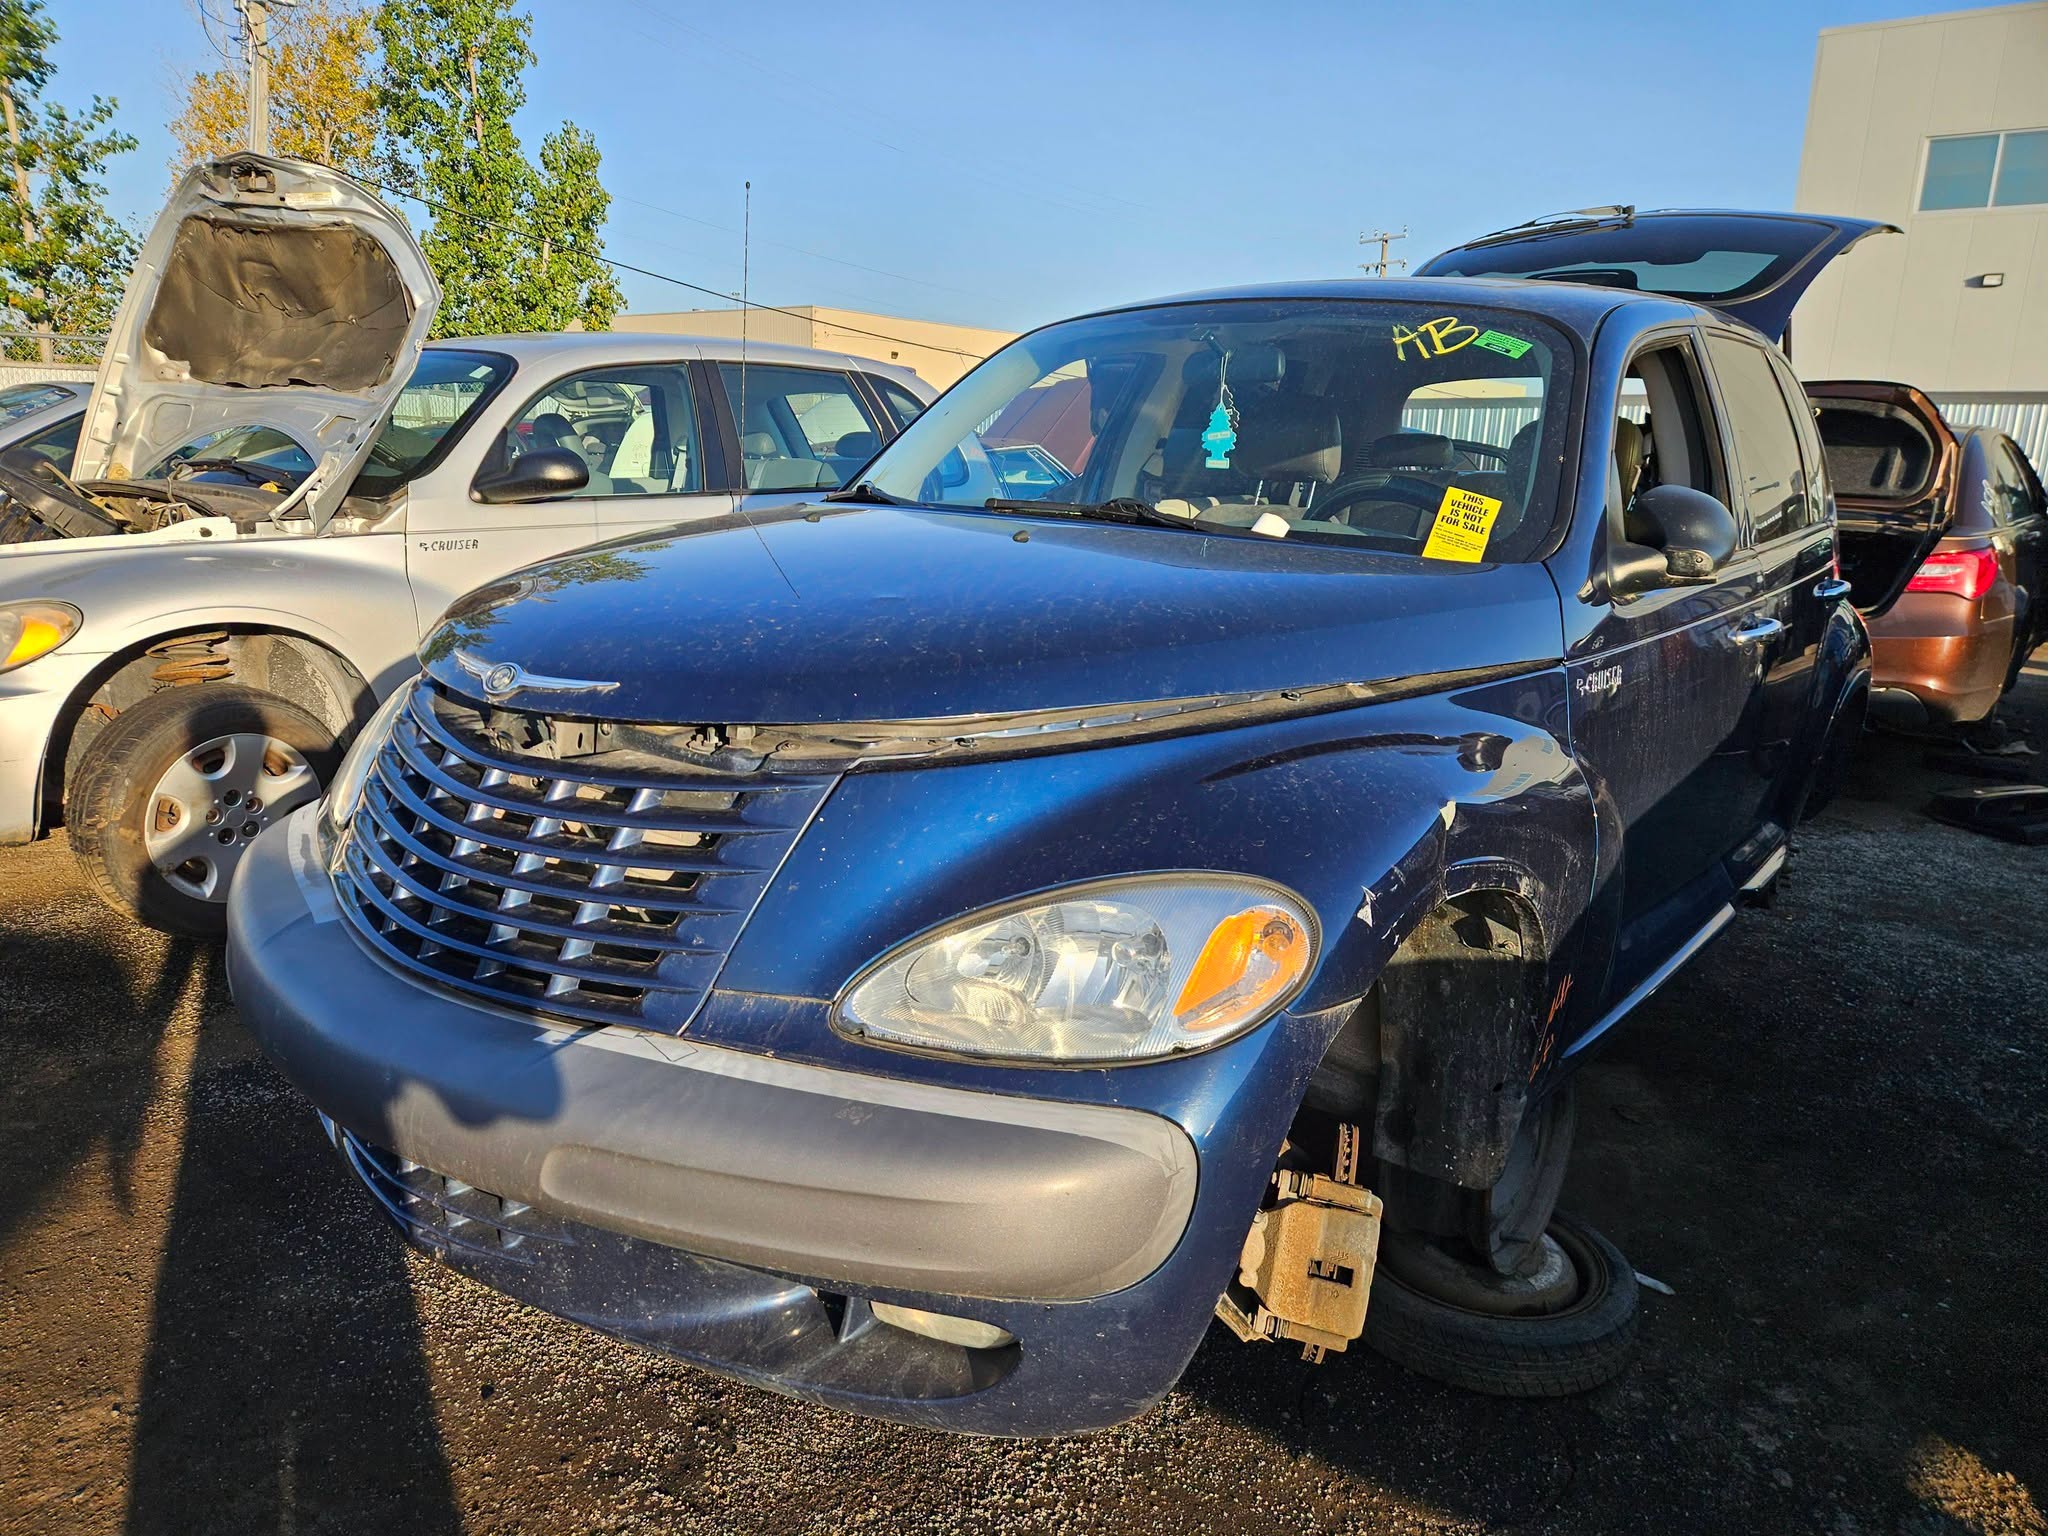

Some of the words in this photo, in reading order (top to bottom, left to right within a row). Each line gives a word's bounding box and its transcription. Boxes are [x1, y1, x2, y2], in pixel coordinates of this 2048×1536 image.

[1392, 316, 1479, 361] AB
[1450, 499, 1489, 517] VEHICLE
[1462, 492, 1485, 506] THIS
[1440, 514, 1460, 527] FOR
[1462, 522, 1486, 536] SALE
[1449, 508, 1461, 517] IS
[1462, 512, 1483, 524] NOT
[431, 539, 479, 552] CRUISER
[1585, 664, 1622, 693] CRUISER
